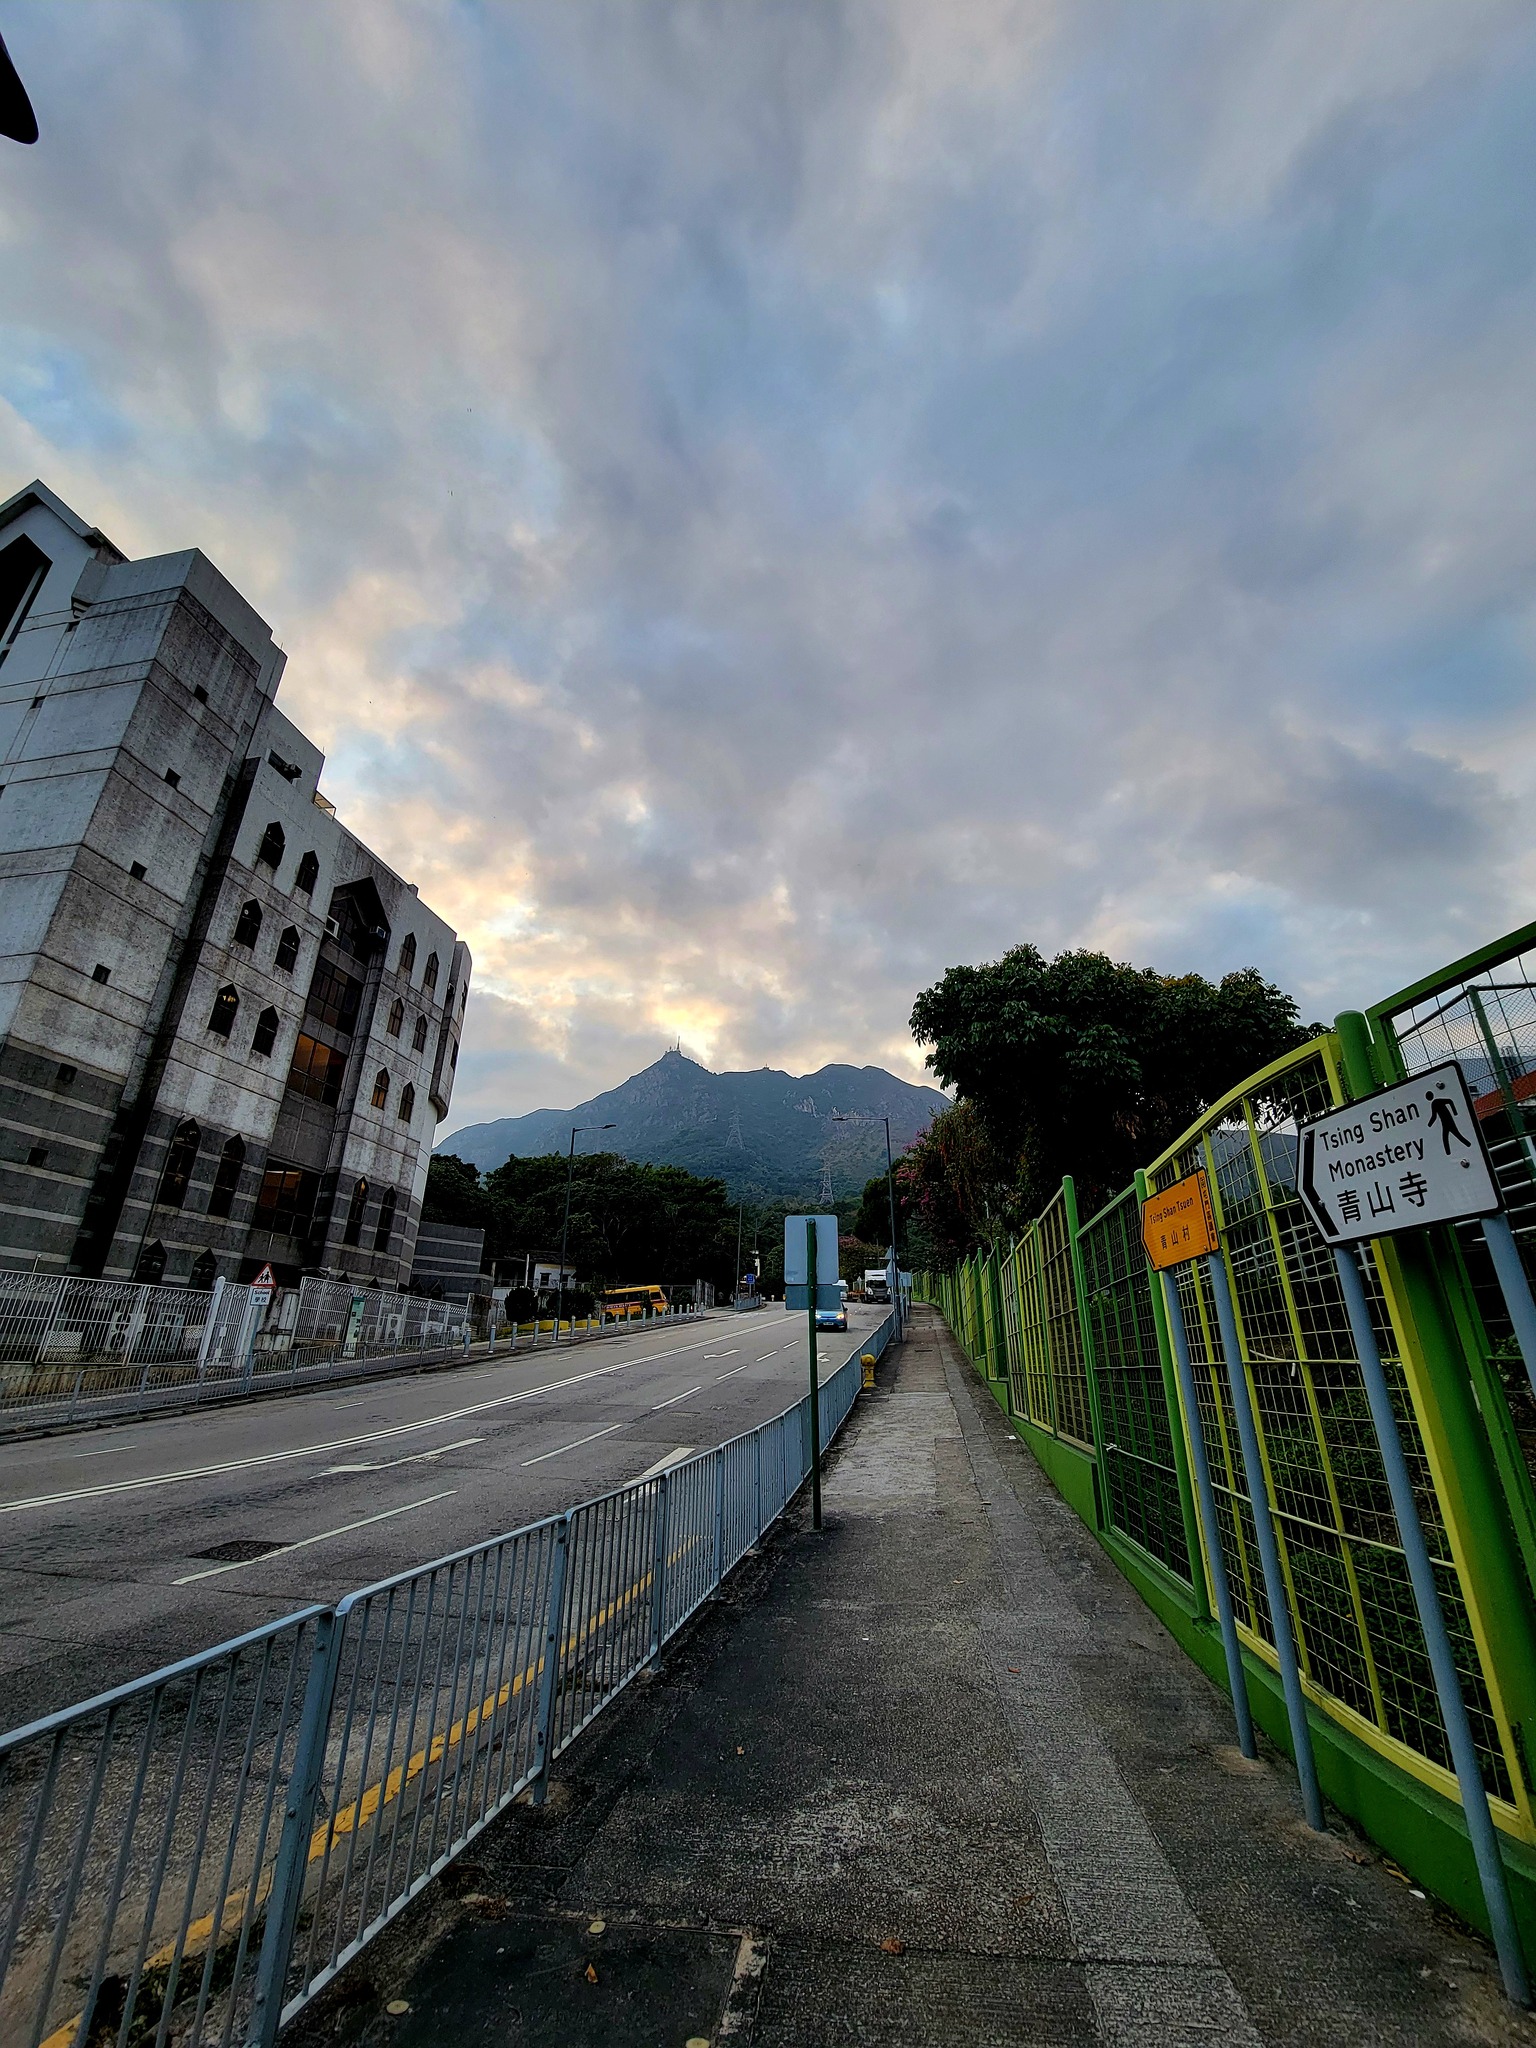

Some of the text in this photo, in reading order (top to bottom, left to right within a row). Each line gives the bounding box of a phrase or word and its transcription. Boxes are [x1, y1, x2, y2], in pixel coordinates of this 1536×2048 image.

[1319, 1103, 1420, 1151] Tsing Shan
[1328, 1138, 1424, 1182] Monastery
[1150, 1197, 1194, 1225] Tsing Shan Tsuen
[1336, 1171, 1428, 1224] 青山寺
